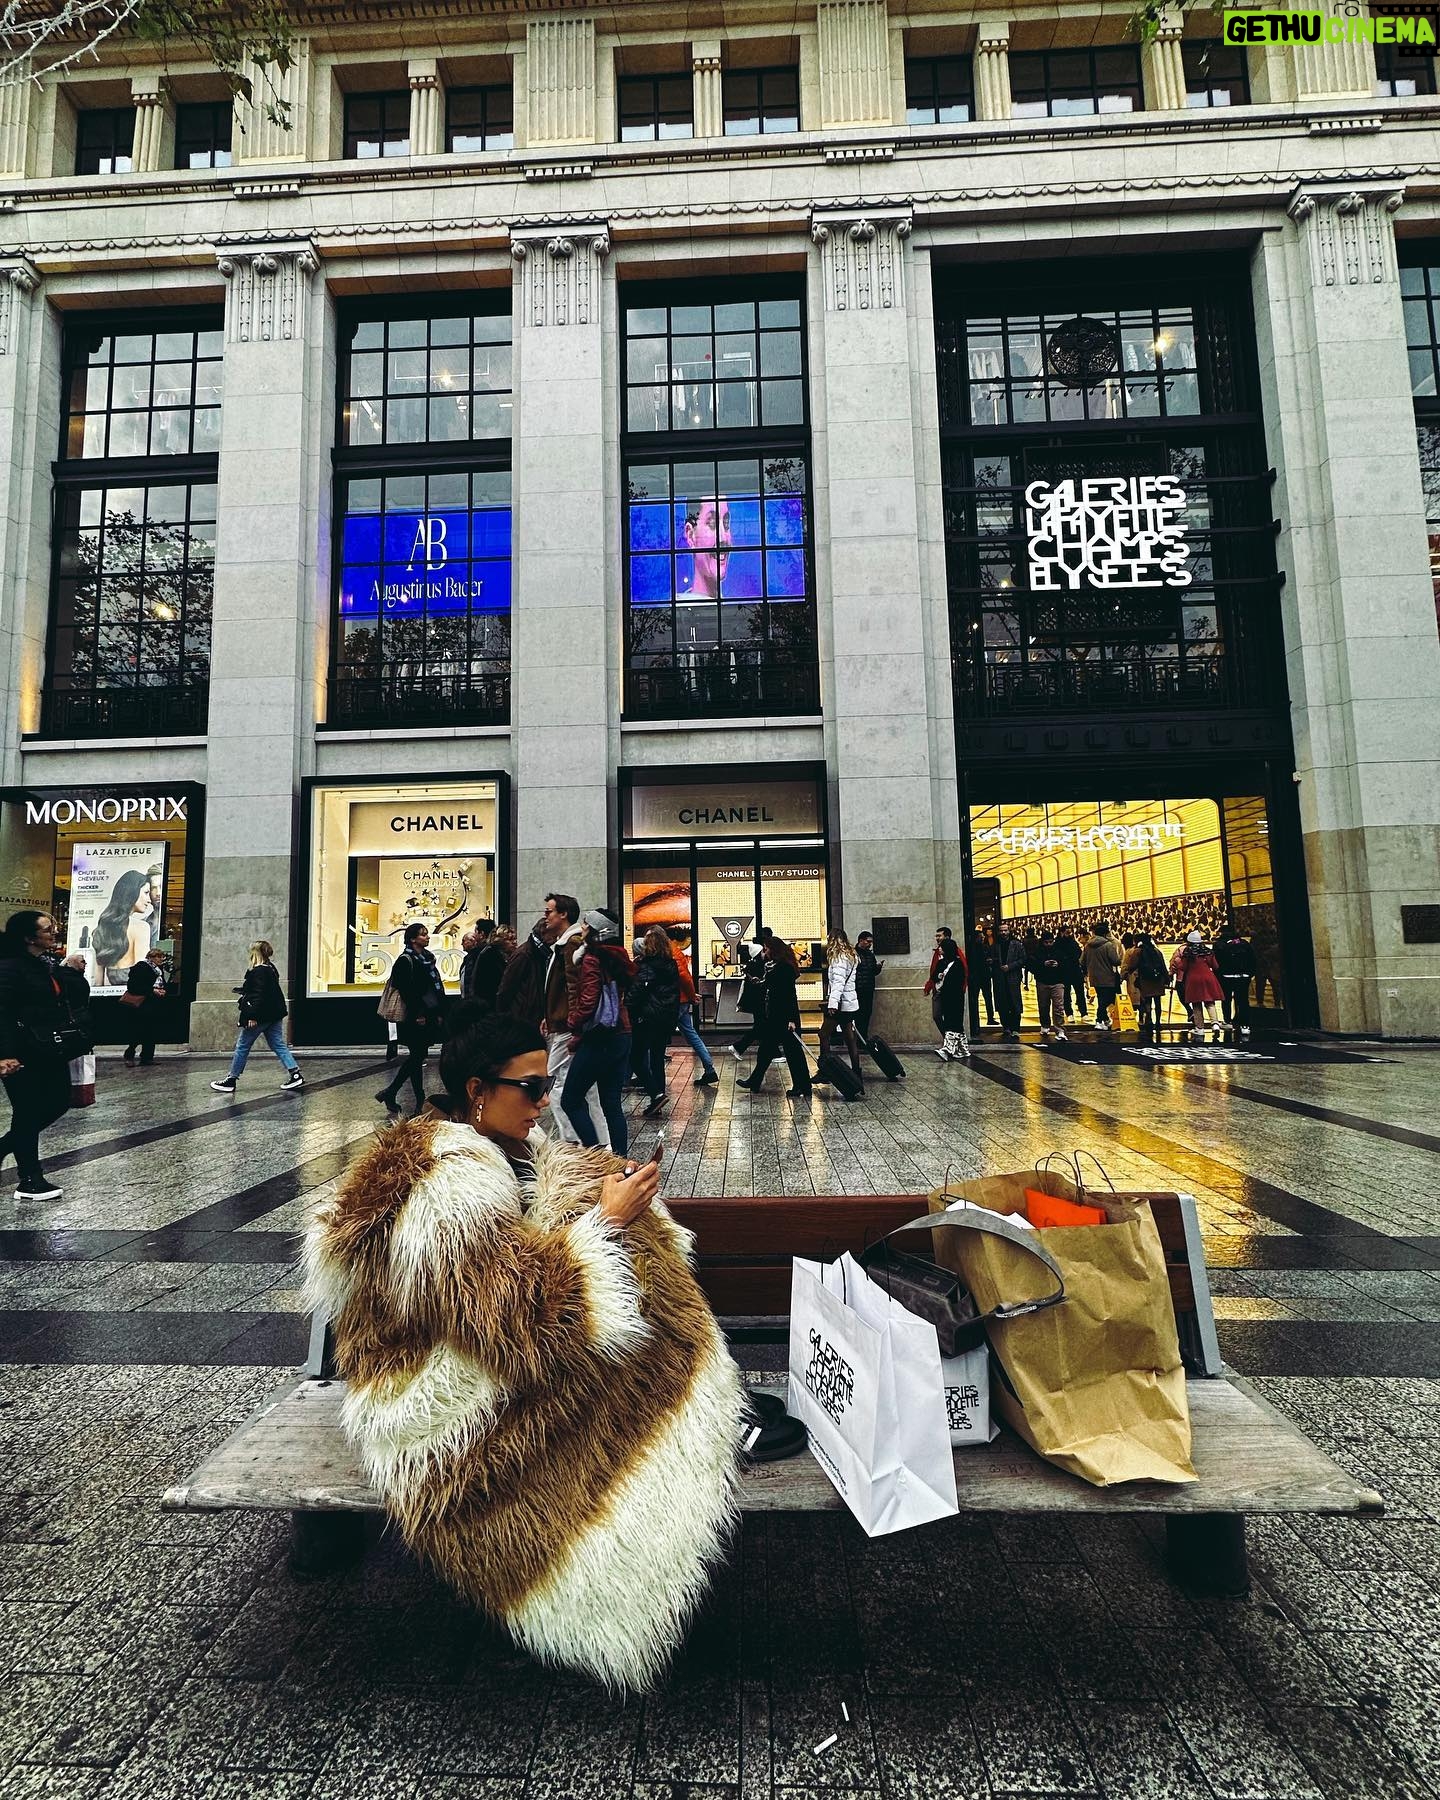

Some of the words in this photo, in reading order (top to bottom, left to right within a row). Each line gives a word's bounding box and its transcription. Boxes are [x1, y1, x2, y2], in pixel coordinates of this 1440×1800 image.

[25, 796, 187, 825] MONOPRIX
[678, 806, 774, 825] CHANEL
[390, 815, 483, 832] CHANEL
[86, 848, 152, 856] LAZARTIGUE
[403, 870, 458, 880] CHANEL
[716, 870, 750, 878] CHANEL
[786, 868, 819, 876] STUDIO
